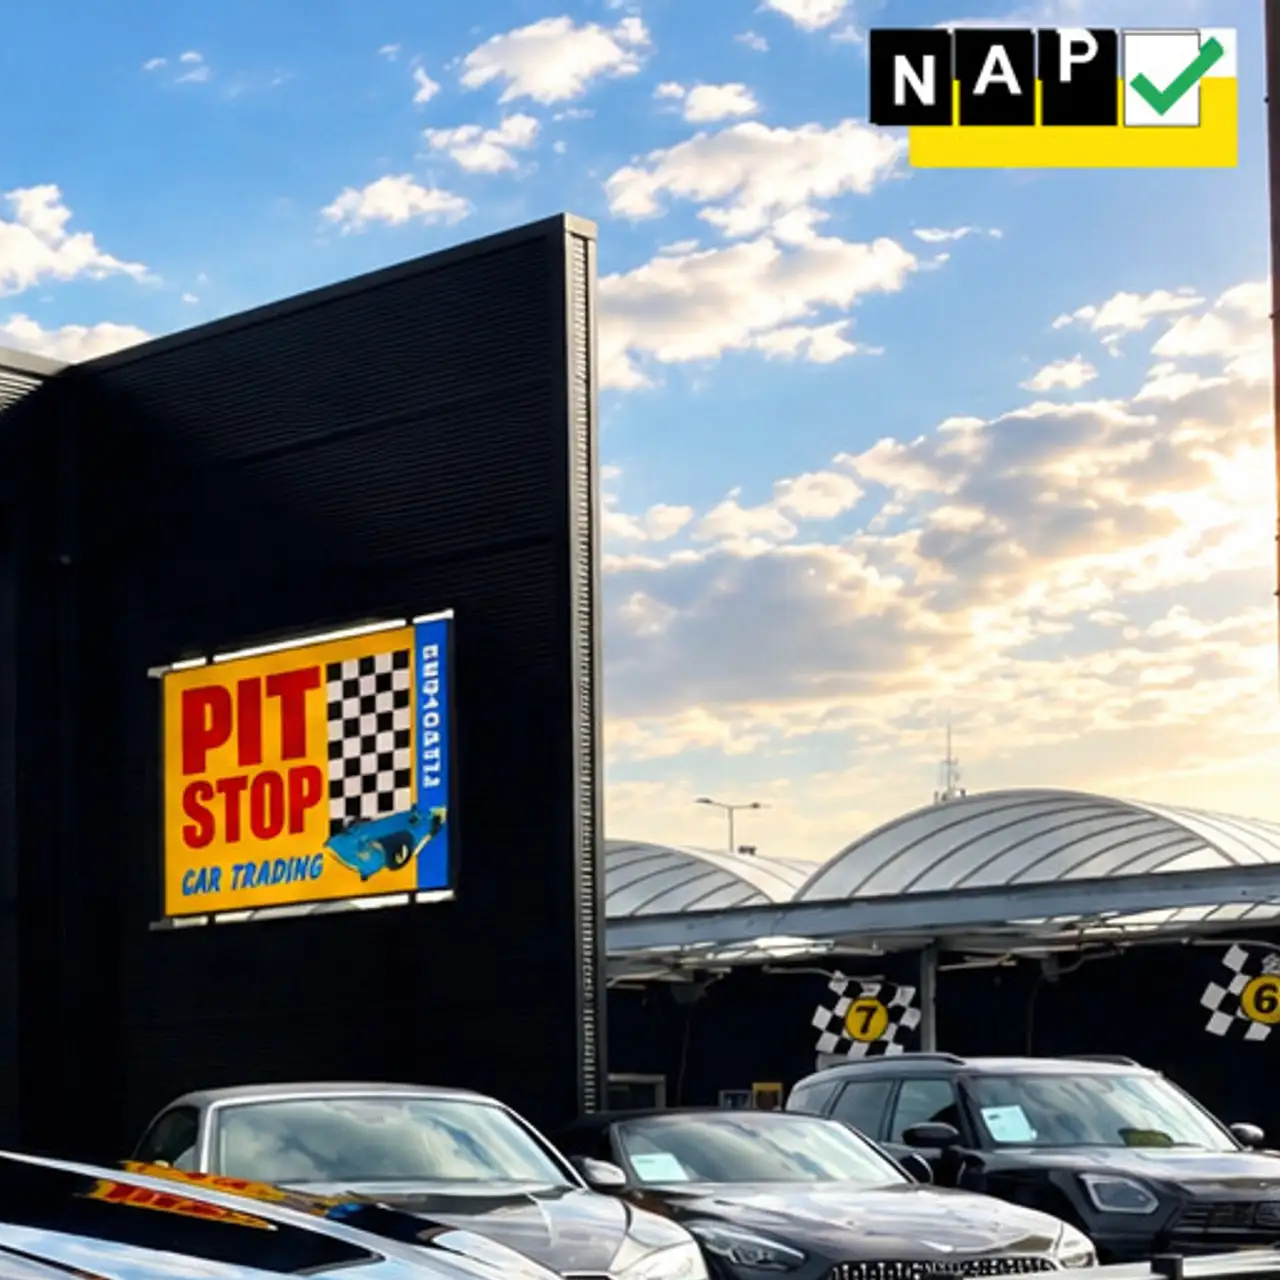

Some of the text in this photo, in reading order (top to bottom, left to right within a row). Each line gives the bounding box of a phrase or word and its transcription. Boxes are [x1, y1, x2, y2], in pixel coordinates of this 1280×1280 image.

[181, 664, 321, 776] PIT
[181, 764, 324, 850] STOP
[181, 852, 325, 896] CAR TRADING
[855, 1005, 879, 1035] 7
[1253, 982, 1280, 1014] 6
